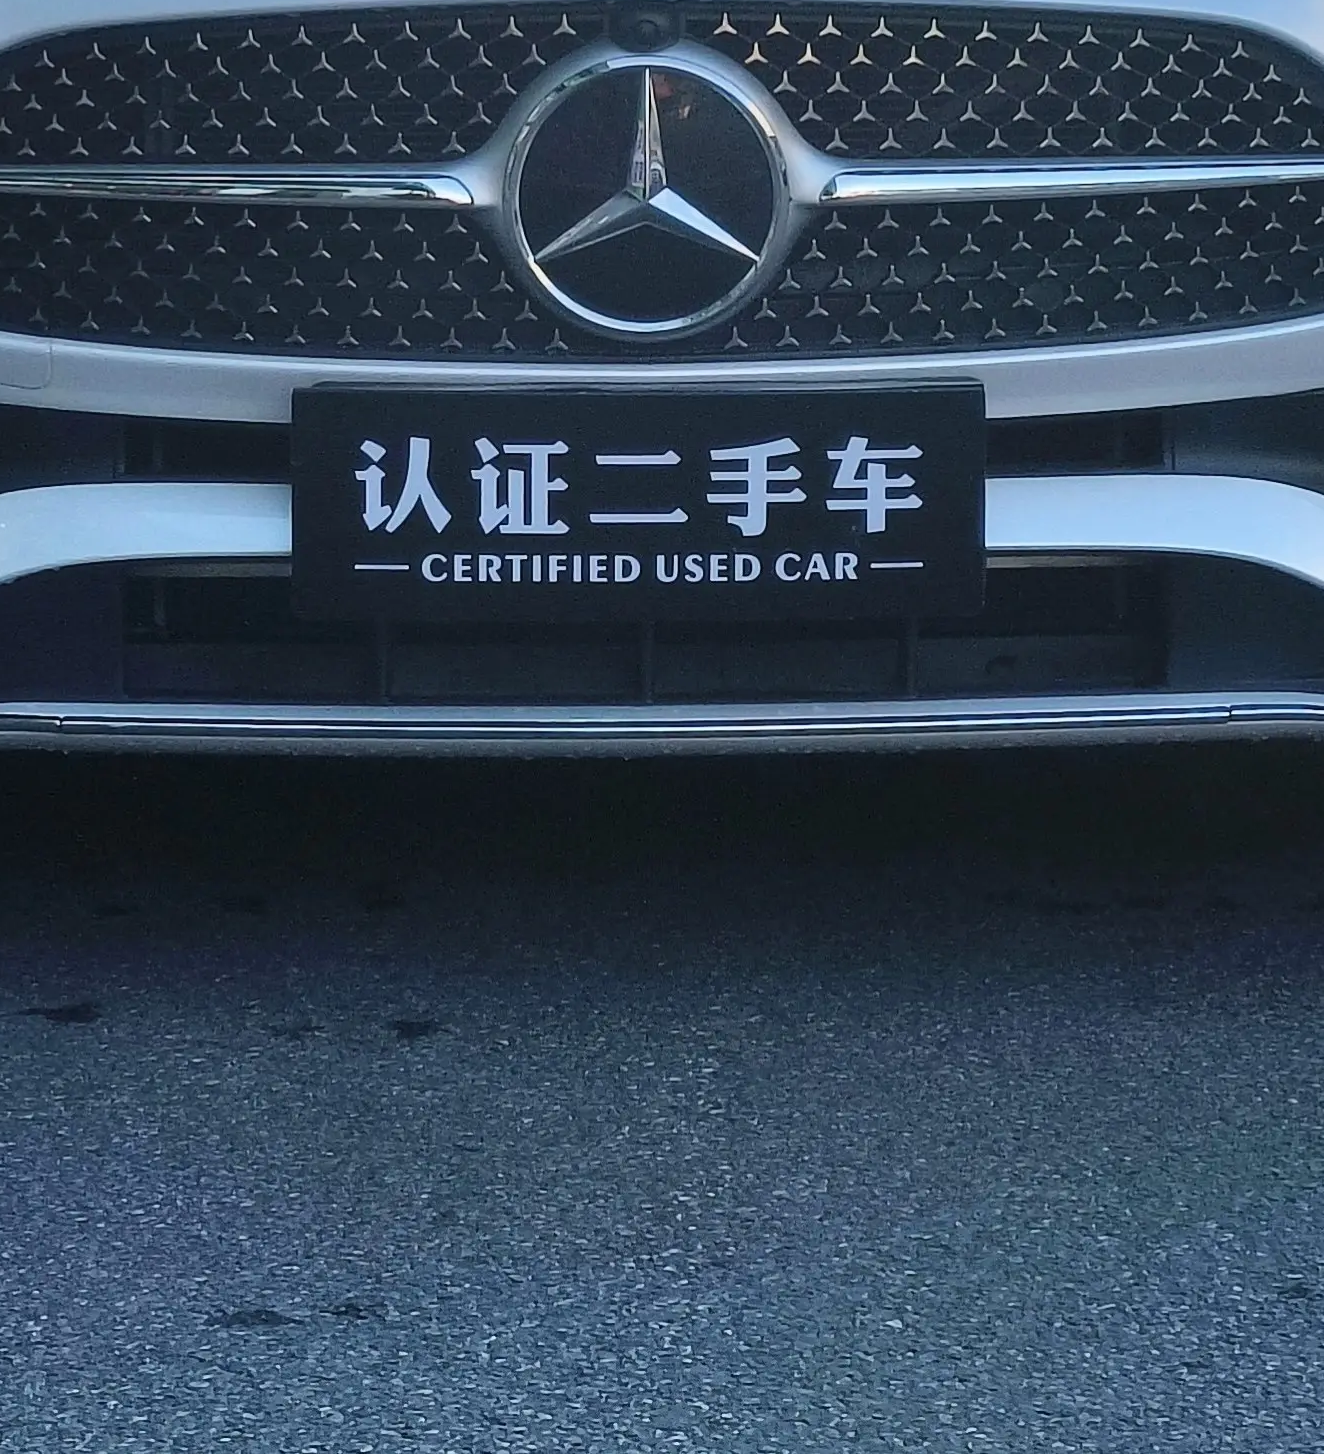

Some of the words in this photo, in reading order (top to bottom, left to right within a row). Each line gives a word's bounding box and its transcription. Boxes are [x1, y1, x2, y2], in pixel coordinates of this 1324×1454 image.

[354, 436, 924, 537] 认证二手车
[420, 553, 641, 584] CERTIFIED
[656, 553, 762, 583] USED
[775, 552, 859, 582] CAR
